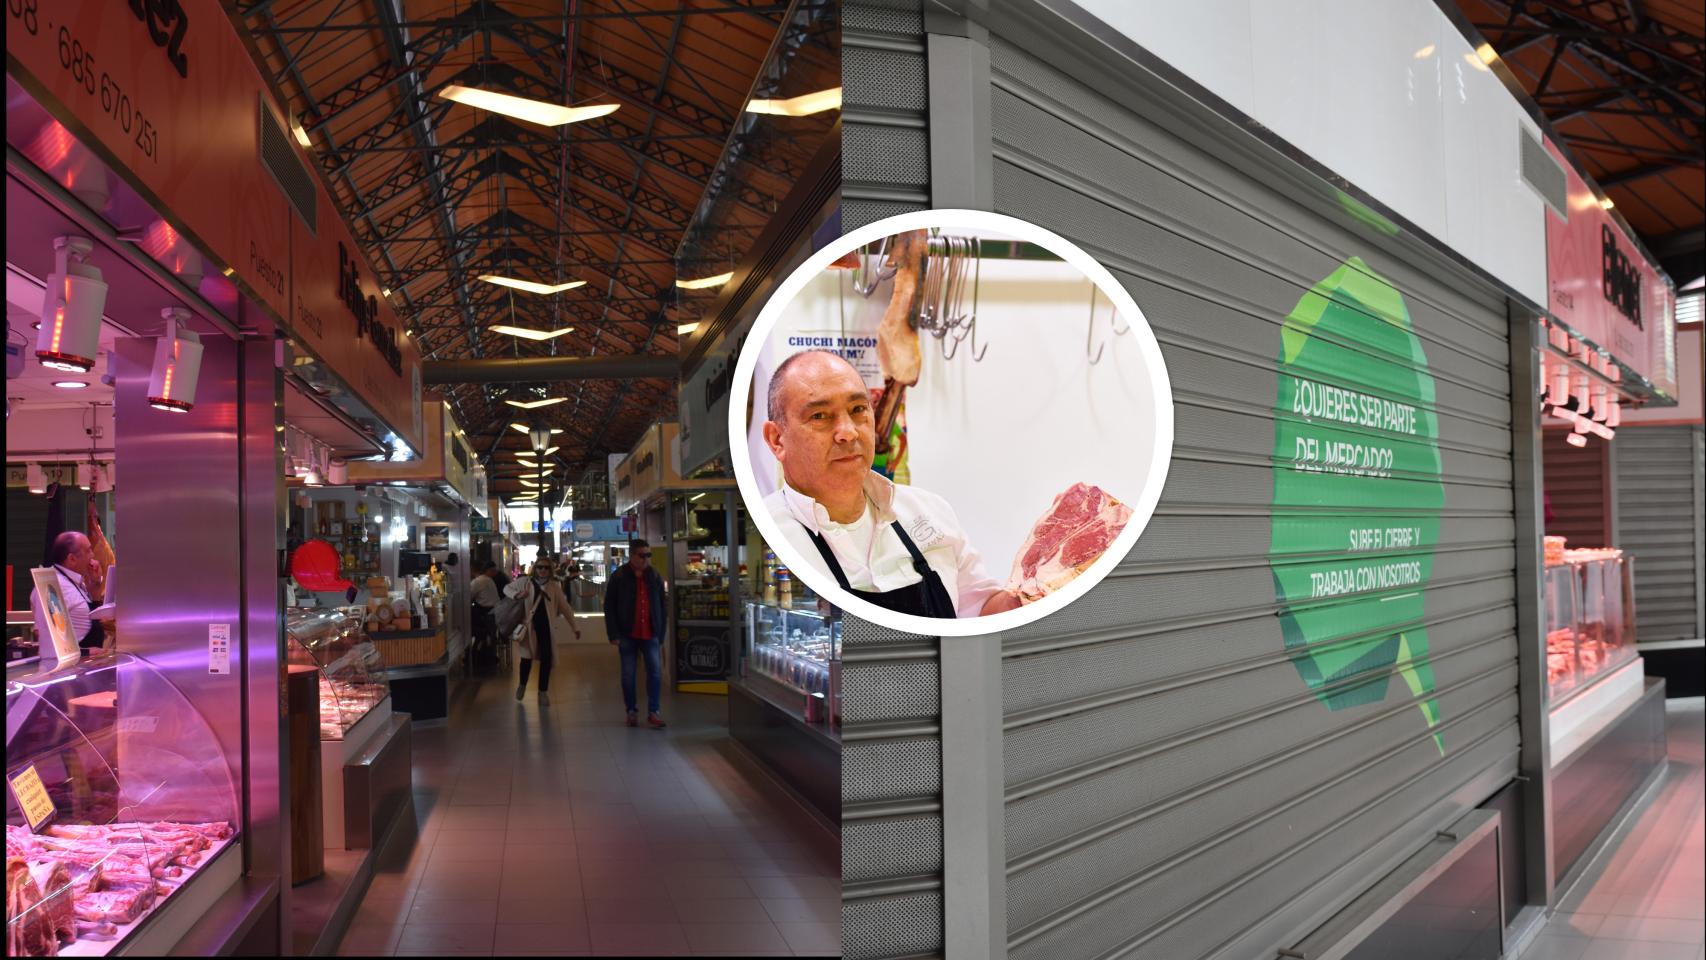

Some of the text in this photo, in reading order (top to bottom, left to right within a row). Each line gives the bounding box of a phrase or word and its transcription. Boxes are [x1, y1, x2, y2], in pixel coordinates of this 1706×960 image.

[58, 26, 96, 96] 685
[100, 72, 131, 134] 670
[135, 111, 158, 164] 251
[788, 337, 833, 347] CHUCHI
[1293, 379, 1416, 435] ¿QUIERES SER PARTE
[1294, 437, 1394, 479] DEL MERCADO?
[1349, 529, 1374, 551] SUBE
[1385, 528, 1412, 550] CIERRE
[1414, 528, 1421, 546] Y
[1310, 561, 1421, 598] TRABAJA CON NOSOTROS
